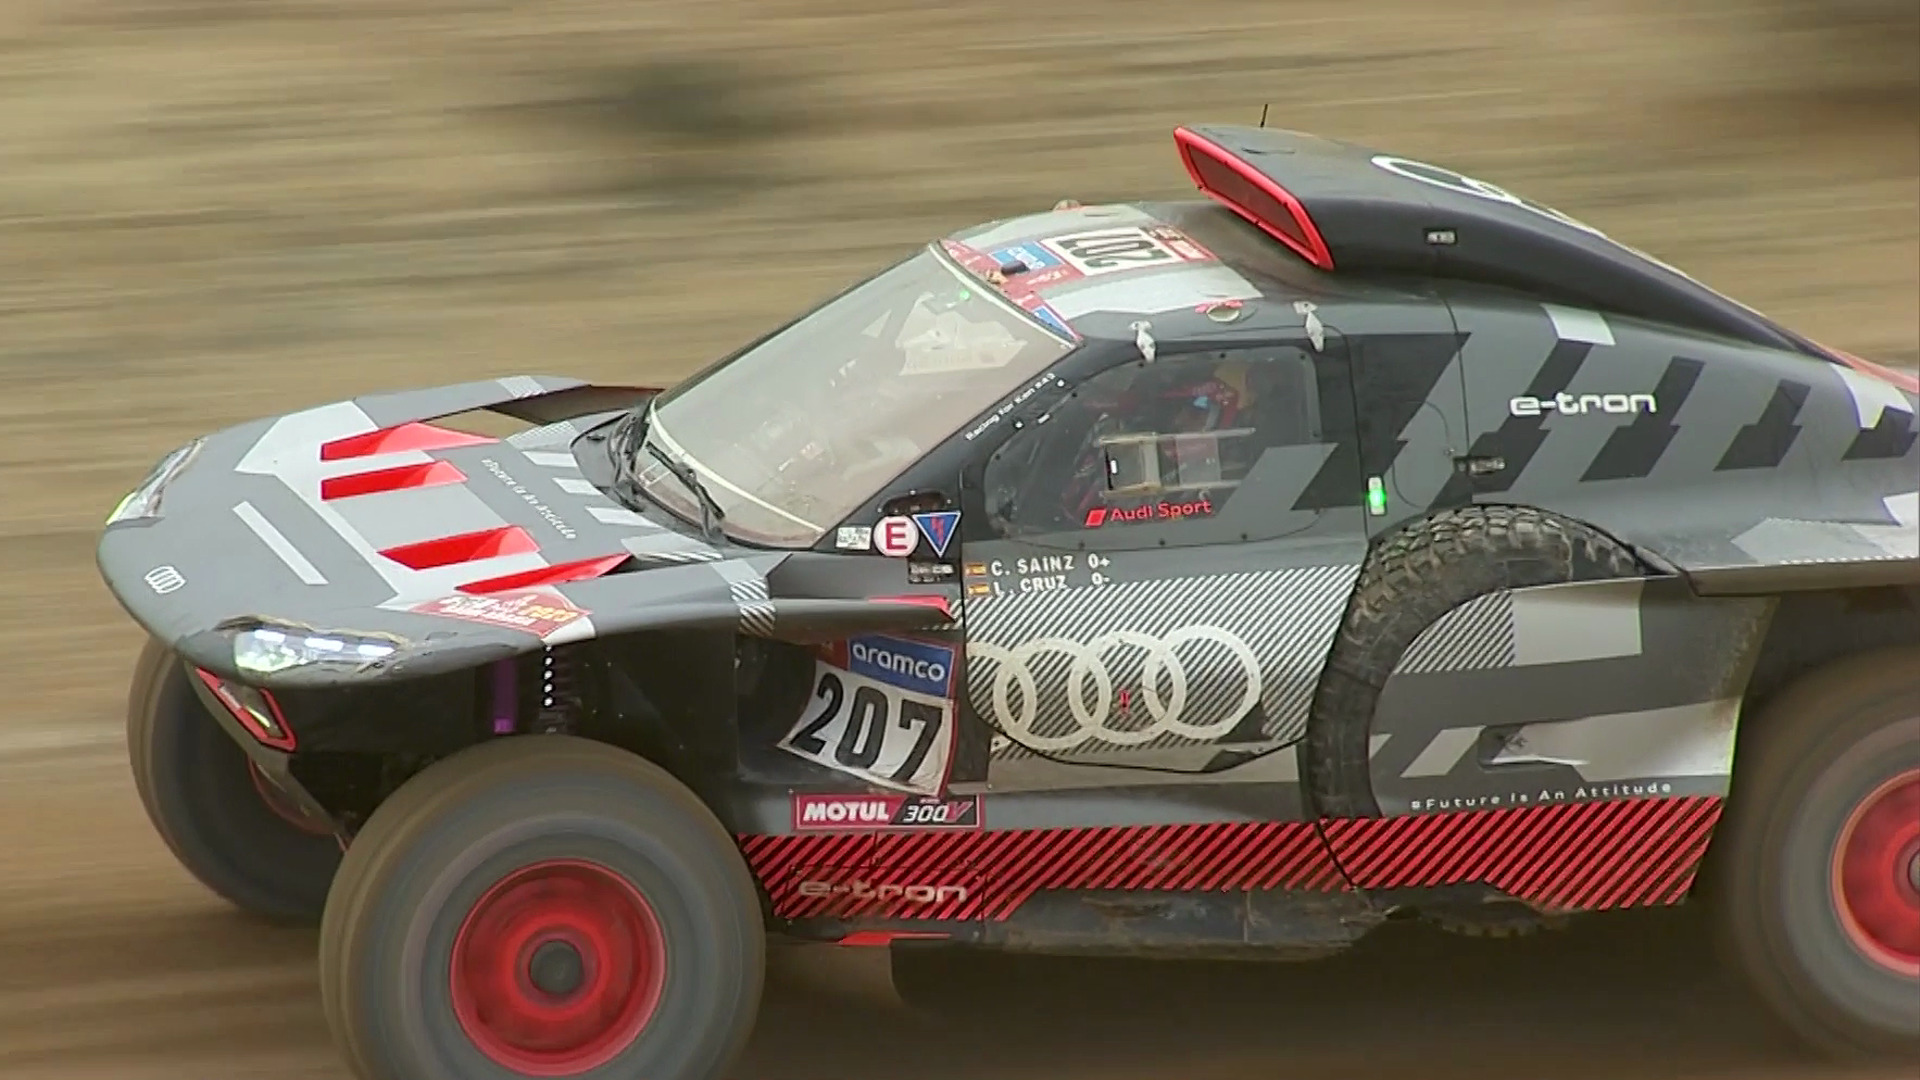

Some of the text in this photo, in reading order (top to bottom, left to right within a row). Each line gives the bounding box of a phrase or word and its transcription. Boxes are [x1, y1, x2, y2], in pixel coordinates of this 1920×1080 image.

[1510, 392, 1657, 416] e-tron
[1110, 500, 1212, 521] Audi Sport
[886, 522, 907, 550] E
[991, 560, 1011, 576] C.
[1017, 555, 1075, 574] SAINZ
[1020, 575, 1069, 592] CRUZ
[852, 642, 946, 682] aramco
[789, 672, 943, 786] 207
[1411, 782, 1672, 810] #Future Is An Attitude
[803, 802, 974, 823] MOTUL 300V
[799, 879, 968, 904] e-tron
